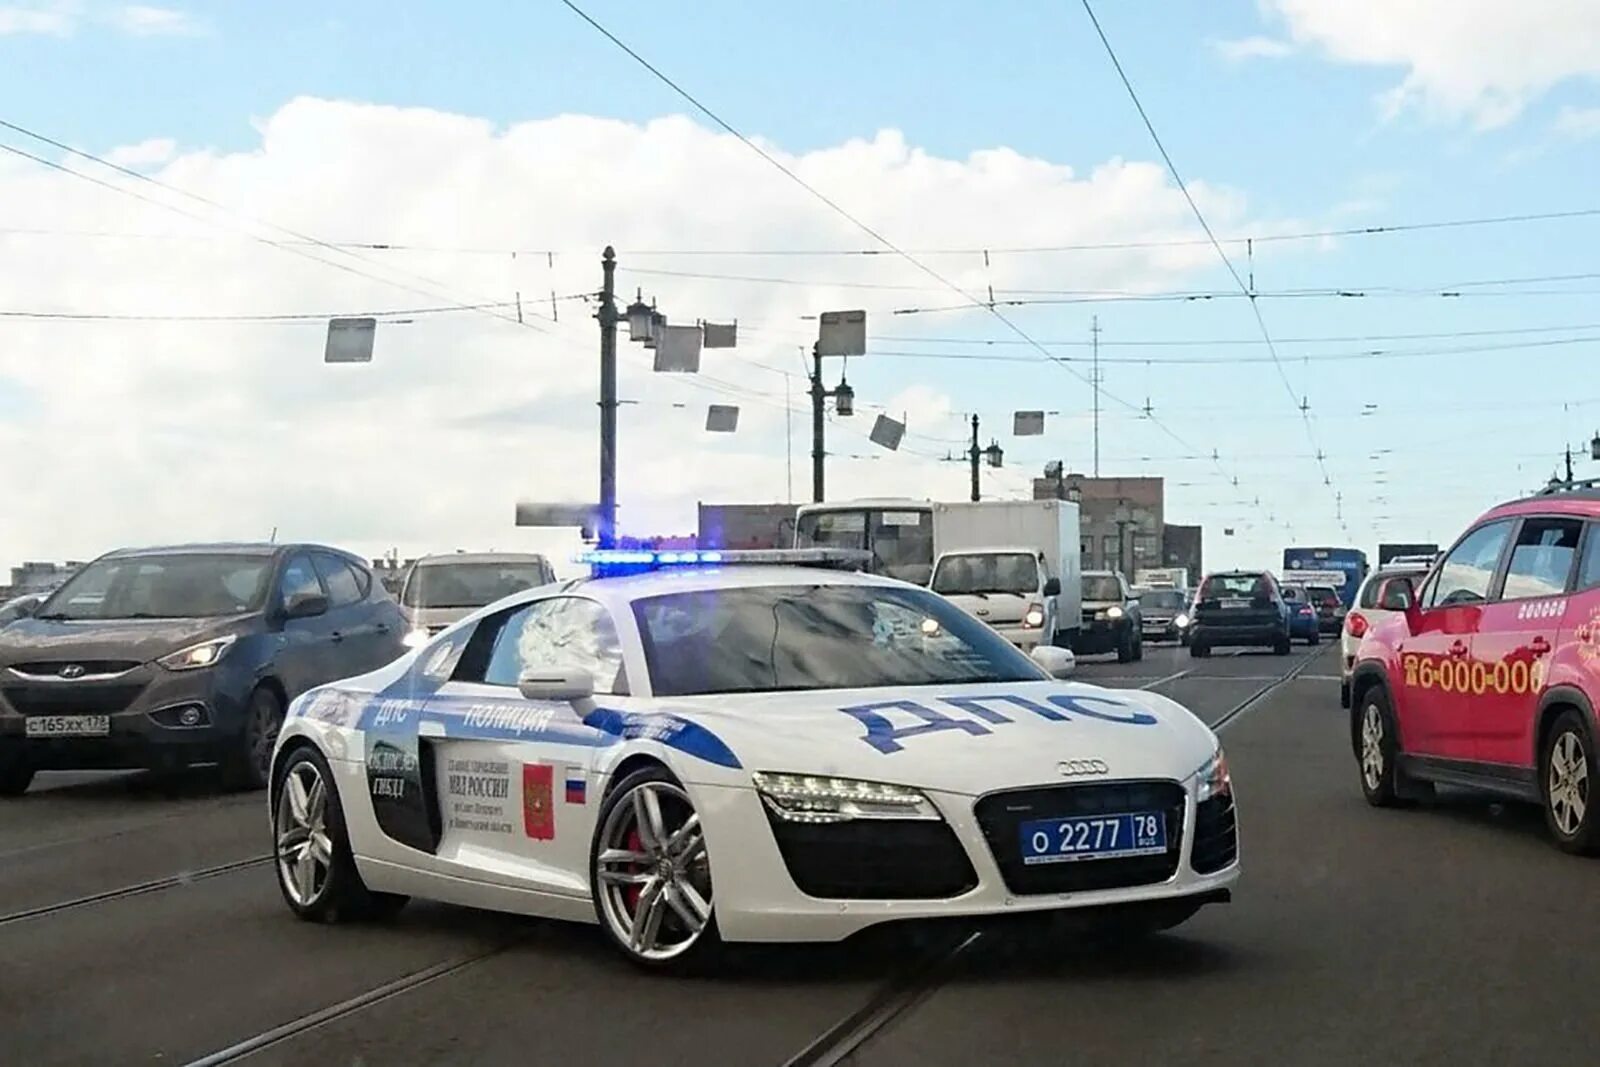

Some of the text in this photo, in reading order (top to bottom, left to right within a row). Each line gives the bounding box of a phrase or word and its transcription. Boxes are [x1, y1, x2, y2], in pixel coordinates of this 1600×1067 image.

[373, 699, 409, 727] ДПС
[463, 704, 554, 736] ПОЛИЦИЯ
[838, 693, 1158, 754] ДПС
[467, 775, 509, 798] РОССИИ
[1058, 819, 1120, 852] 2277
[1134, 815, 1158, 838] 78
